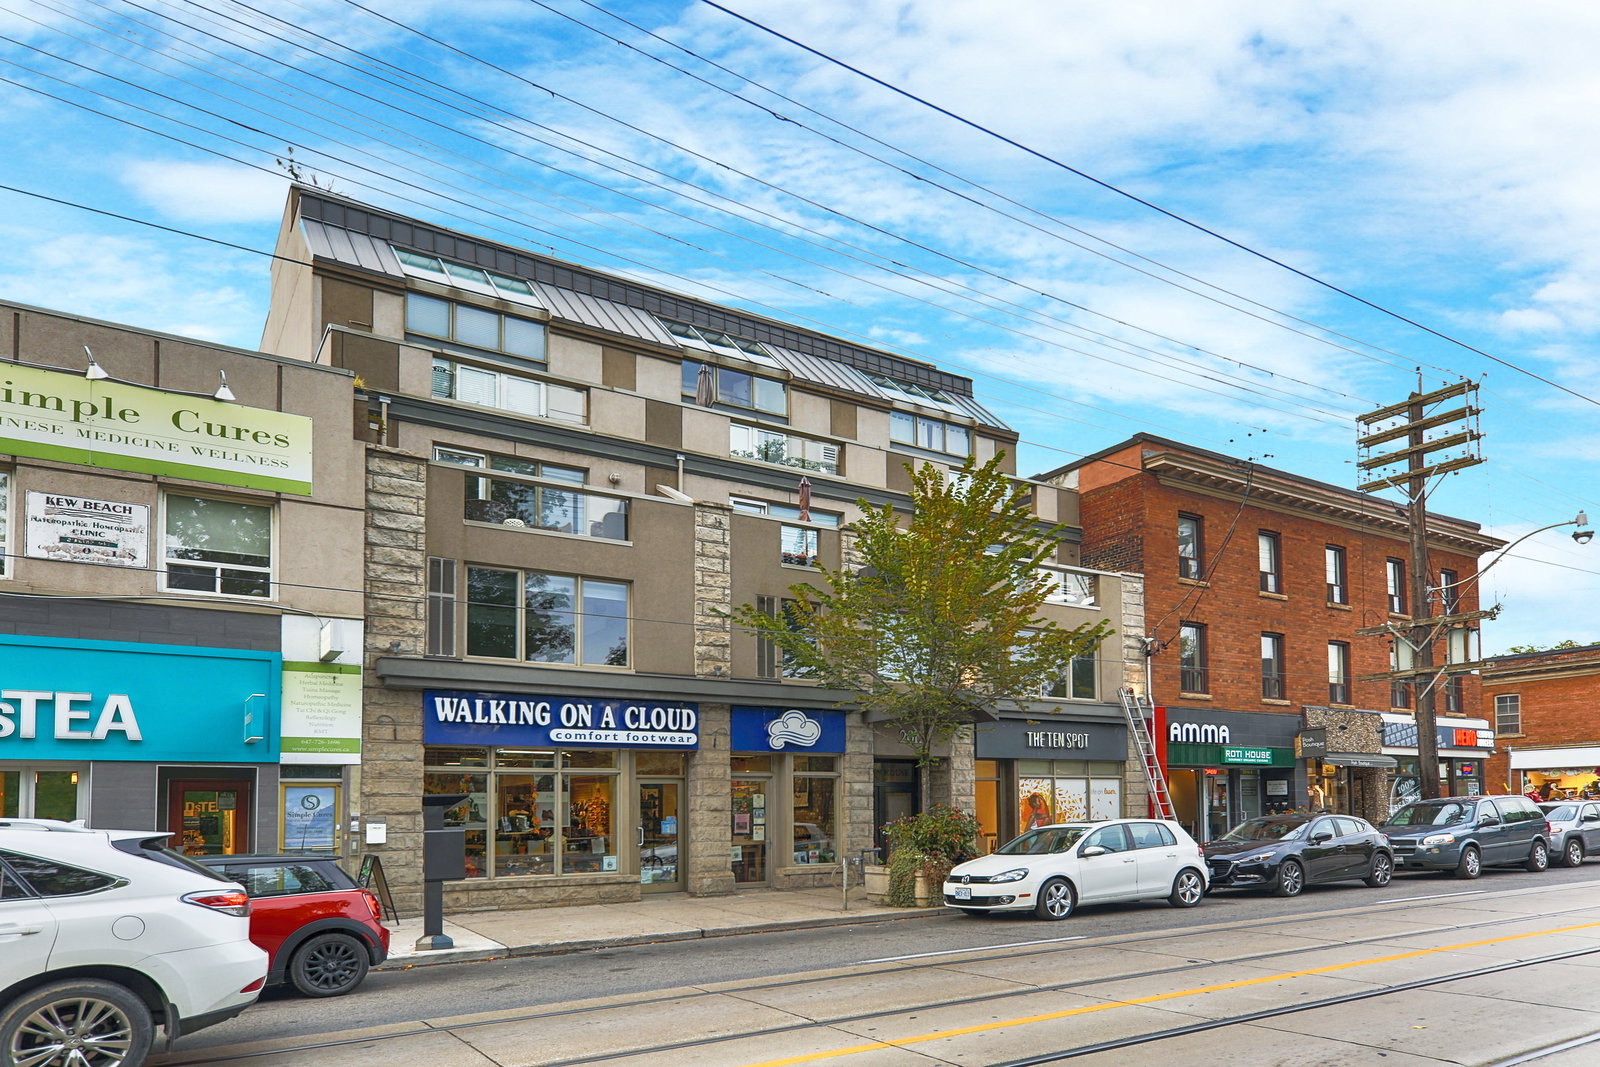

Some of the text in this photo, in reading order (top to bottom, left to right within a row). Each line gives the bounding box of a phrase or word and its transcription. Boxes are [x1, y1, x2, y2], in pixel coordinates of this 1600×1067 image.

[0, 380, 290, 449] imple Cures
[76, 428, 180, 453] MEDICINE
[190, 446, 289, 469] WELLNESS
[45, 495, 133, 515] KEW BEACH
[434, 697, 697, 731] WALKING ON A CLOUD
[555, 730, 693, 744] comfort footwear
[1026, 731, 1090, 749] THE TEN SPOT
[1170, 722, 1230, 743] AMMA
[1455, 728, 1477, 747] HERO
[1225, 750, 1271, 759] ROTI HOUSE
[1397, 778, 1416, 794] 100%
[185, 801, 220, 813] DsTE
[287, 811, 311, 820] Simple
